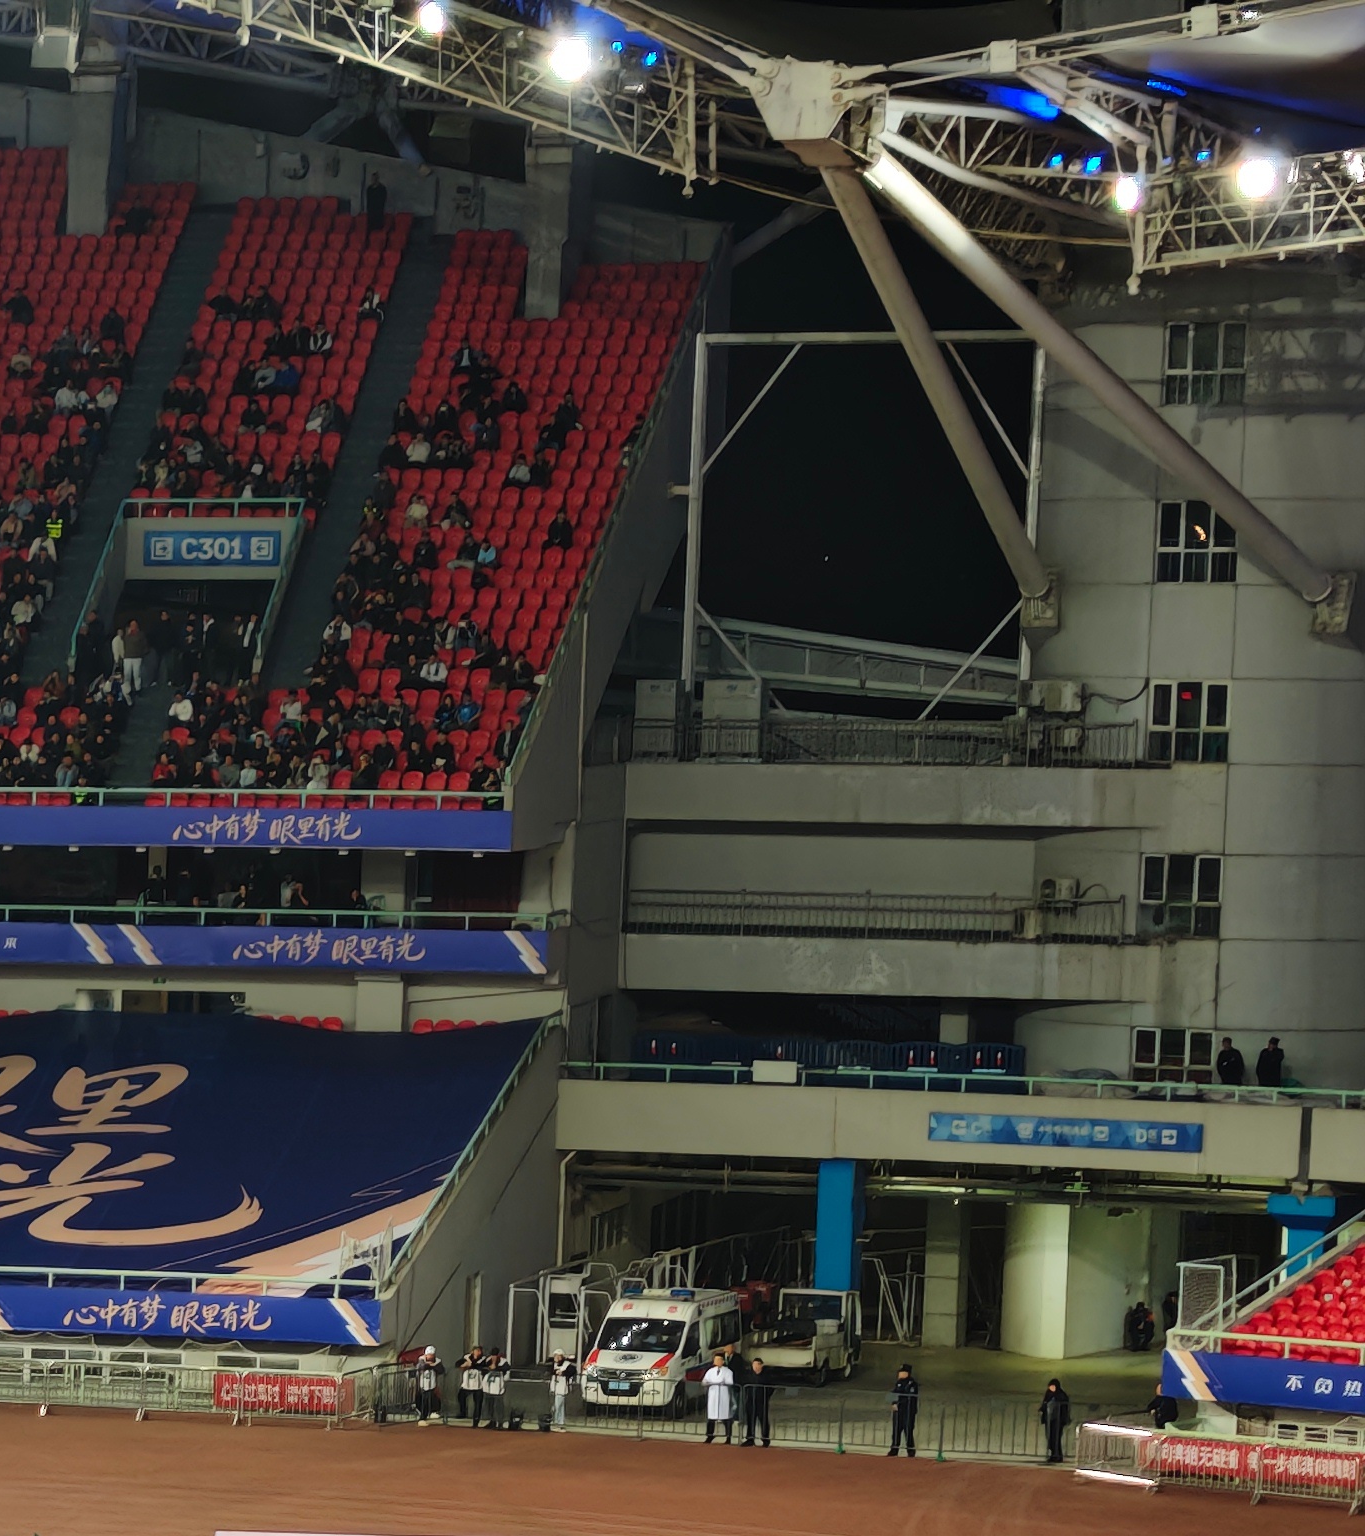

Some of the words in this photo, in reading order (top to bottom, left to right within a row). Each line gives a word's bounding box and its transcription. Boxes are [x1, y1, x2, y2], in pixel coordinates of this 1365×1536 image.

[180, 537, 243, 560] C301
[172, 809, 266, 846] 心中有梦
[268, 811, 362, 845] 眼里有光
[232, 929, 329, 965] 心中有梦
[331, 933, 426, 965] 眼里有光
[62, 1294, 167, 1332] 心中有梦
[170, 1299, 272, 1334] 眼里有光
